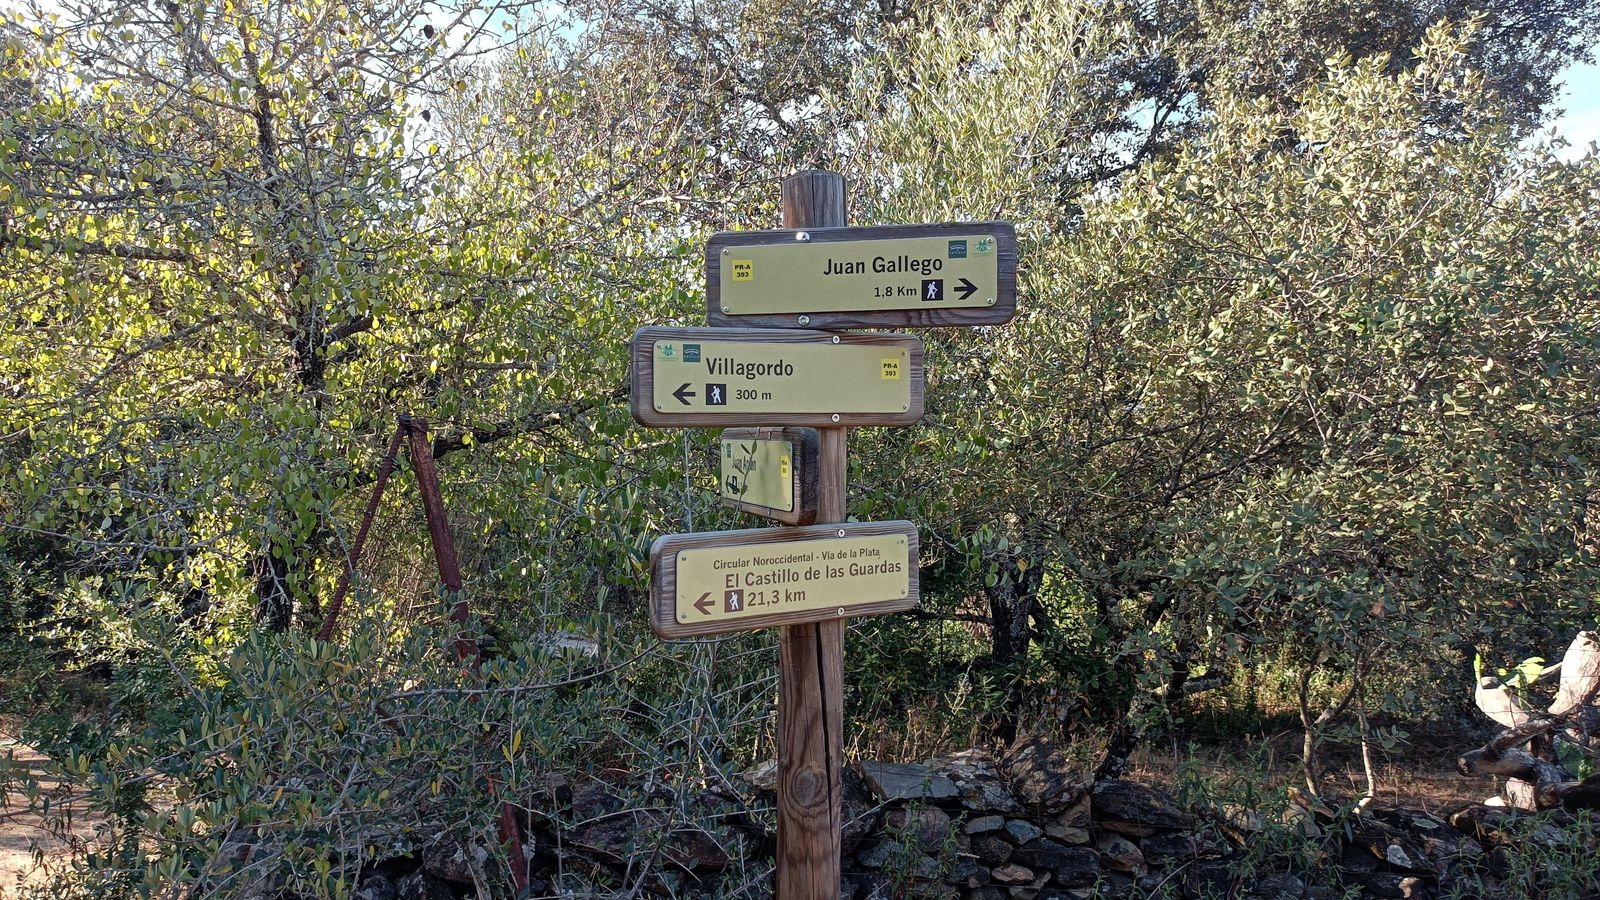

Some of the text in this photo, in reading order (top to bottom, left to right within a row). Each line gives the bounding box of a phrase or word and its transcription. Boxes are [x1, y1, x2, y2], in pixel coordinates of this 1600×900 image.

[823, 255, 943, 276] Juan Gallego
[874, 286, 917, 298] 1,8 Km
[706, 357, 794, 380] Villagordo
[735, 389, 772, 400] 300 m
[713, 558, 751, 570] Circular
[753, 552, 814, 567] Noroccidental
[821, 550, 835, 561] Vía
[837, 549, 848, 560] de
[849, 549, 858, 559] la
[860, 547, 880, 558] Plata
[725, 560, 902, 589] El Castillo de las Guardas
[747, 588, 806, 607] 21,3 km
